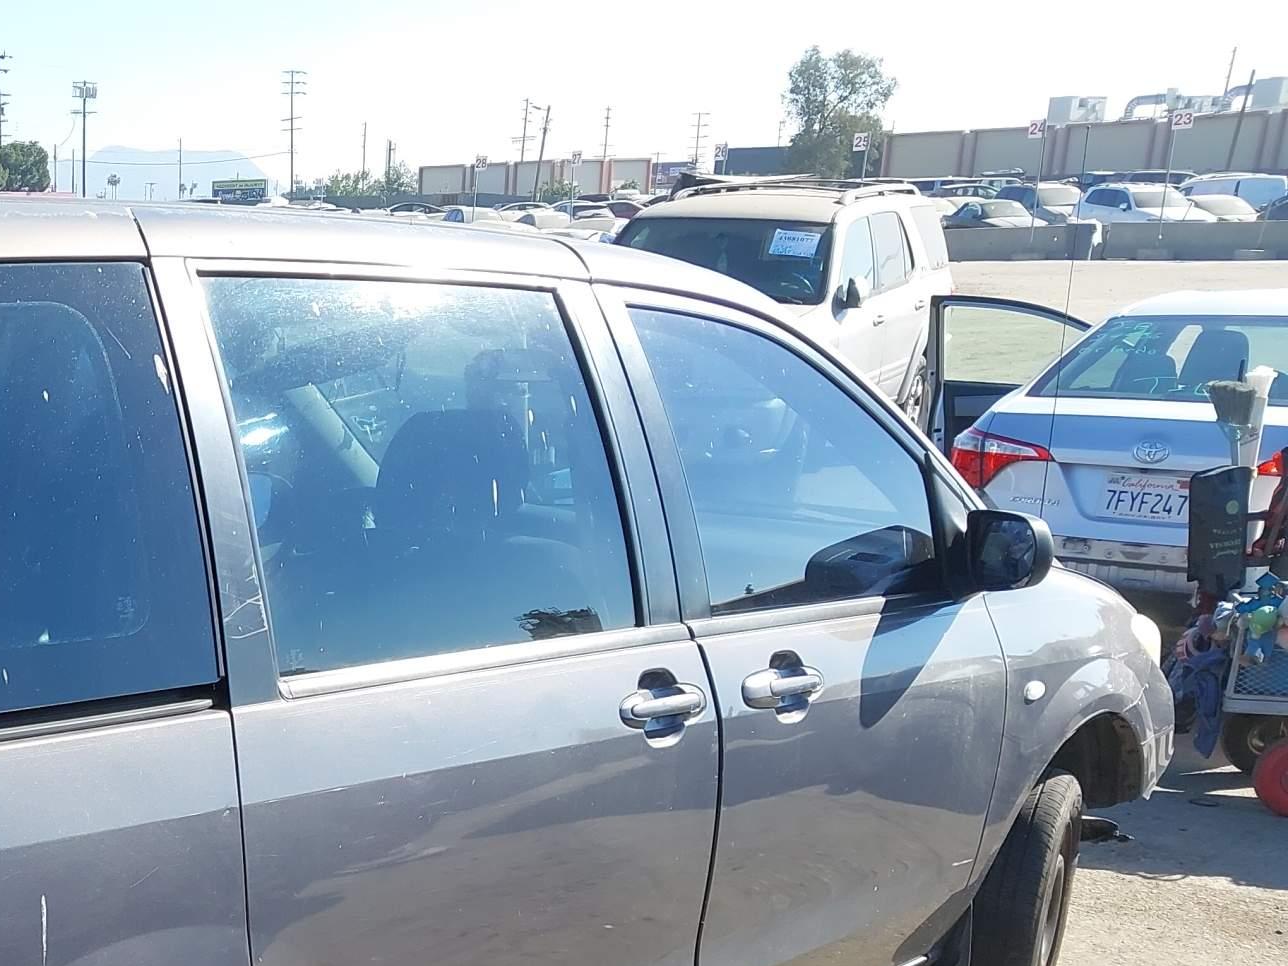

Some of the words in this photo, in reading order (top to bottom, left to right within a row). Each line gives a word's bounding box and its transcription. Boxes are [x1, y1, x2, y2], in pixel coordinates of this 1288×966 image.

[1173, 112, 1193, 126] 23
[1030, 122, 1045, 135] 24
[855, 136, 869, 148] 25
[475, 158, 487, 169] 28
[572, 153, 582, 165] 27
[1105, 489, 1189, 516] 7FYF247
